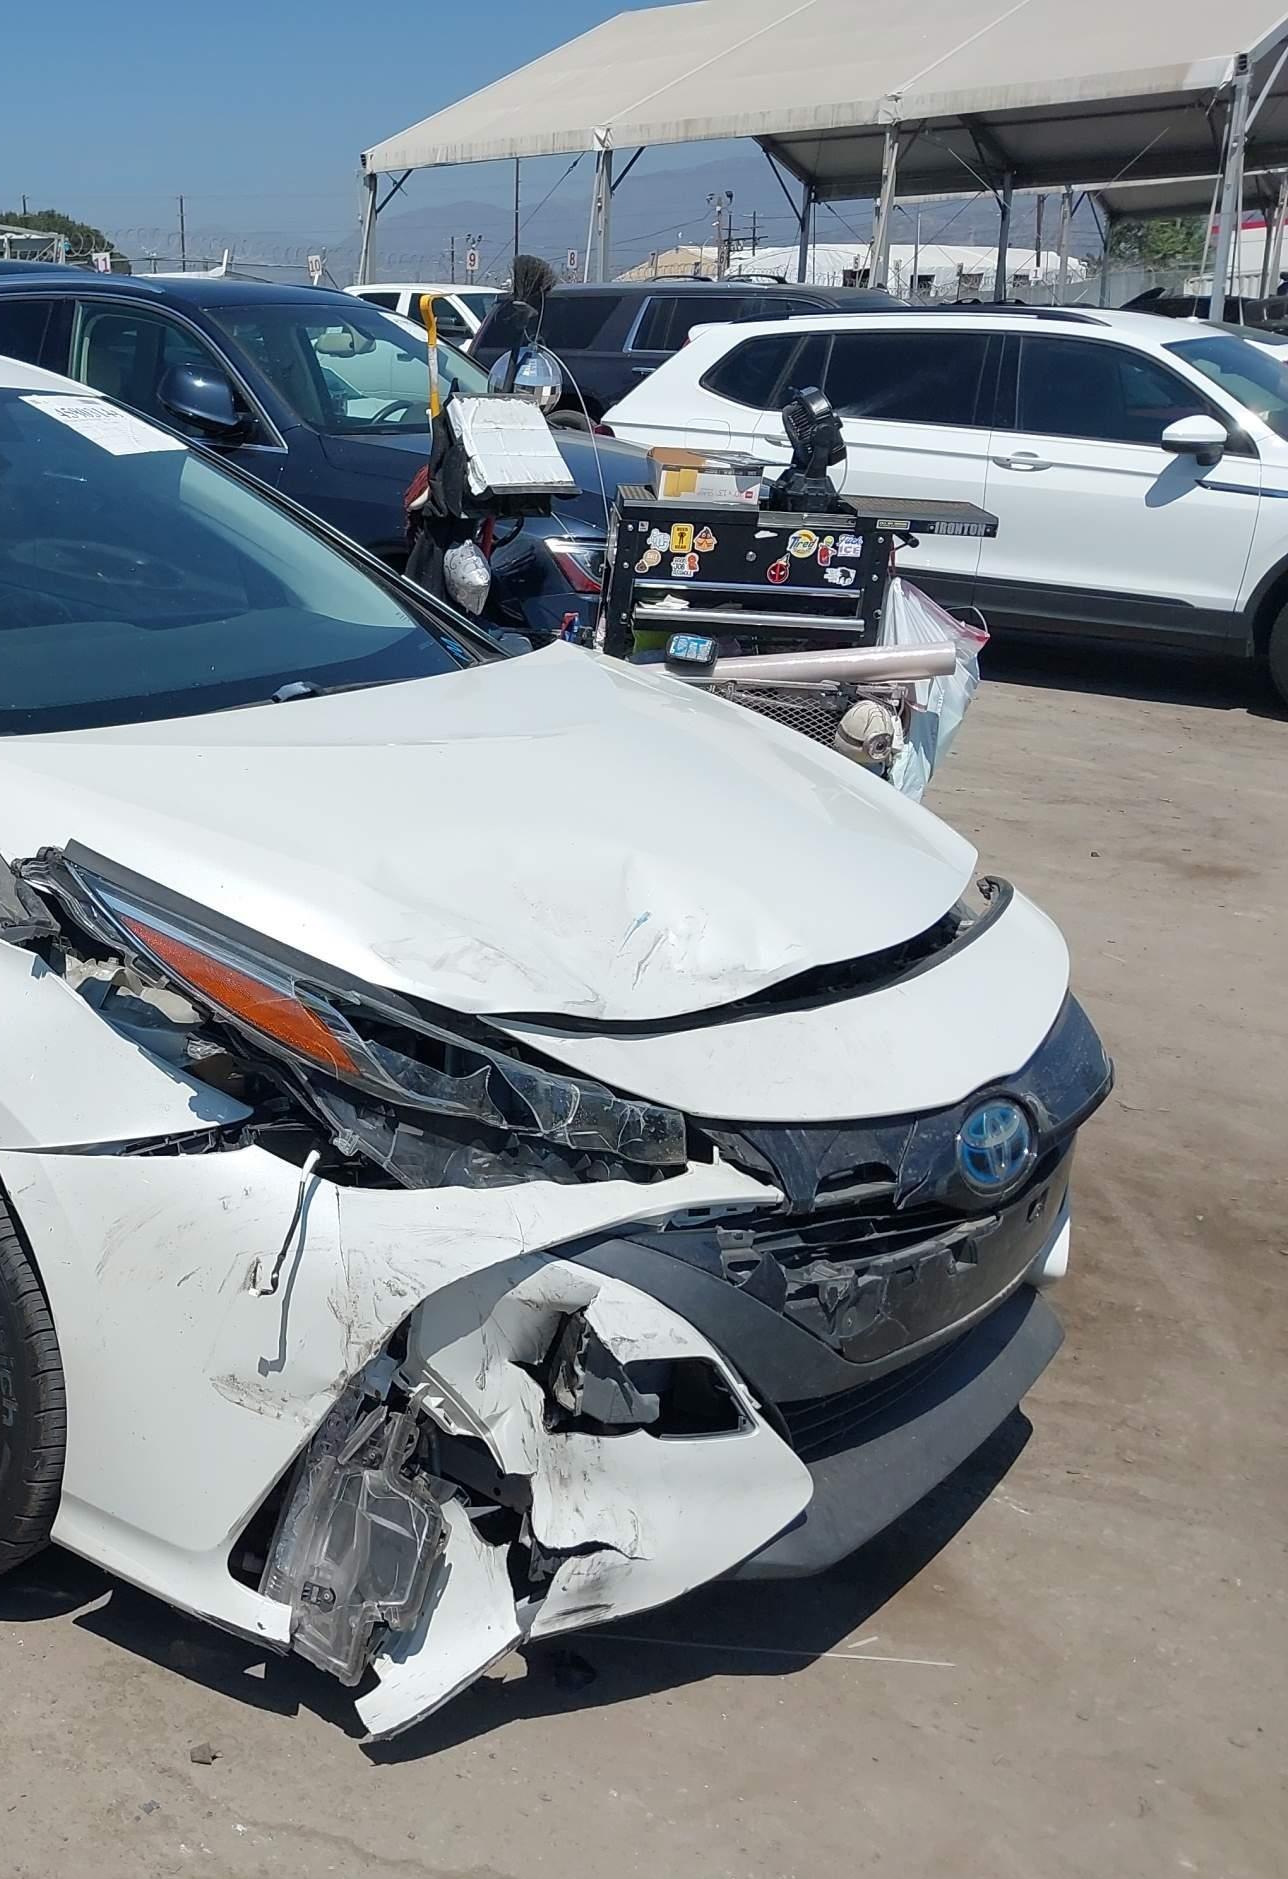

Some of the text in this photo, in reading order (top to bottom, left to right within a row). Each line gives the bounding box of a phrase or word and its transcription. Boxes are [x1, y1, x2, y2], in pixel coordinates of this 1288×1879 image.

[93, 255, 110, 272] 11
[309, 258, 321, 273] 10
[468, 252, 476, 267] 9
[568, 251, 575, 266] 8
[933, 521, 987, 537] IRONTON
[839, 546, 861, 554] ICE
